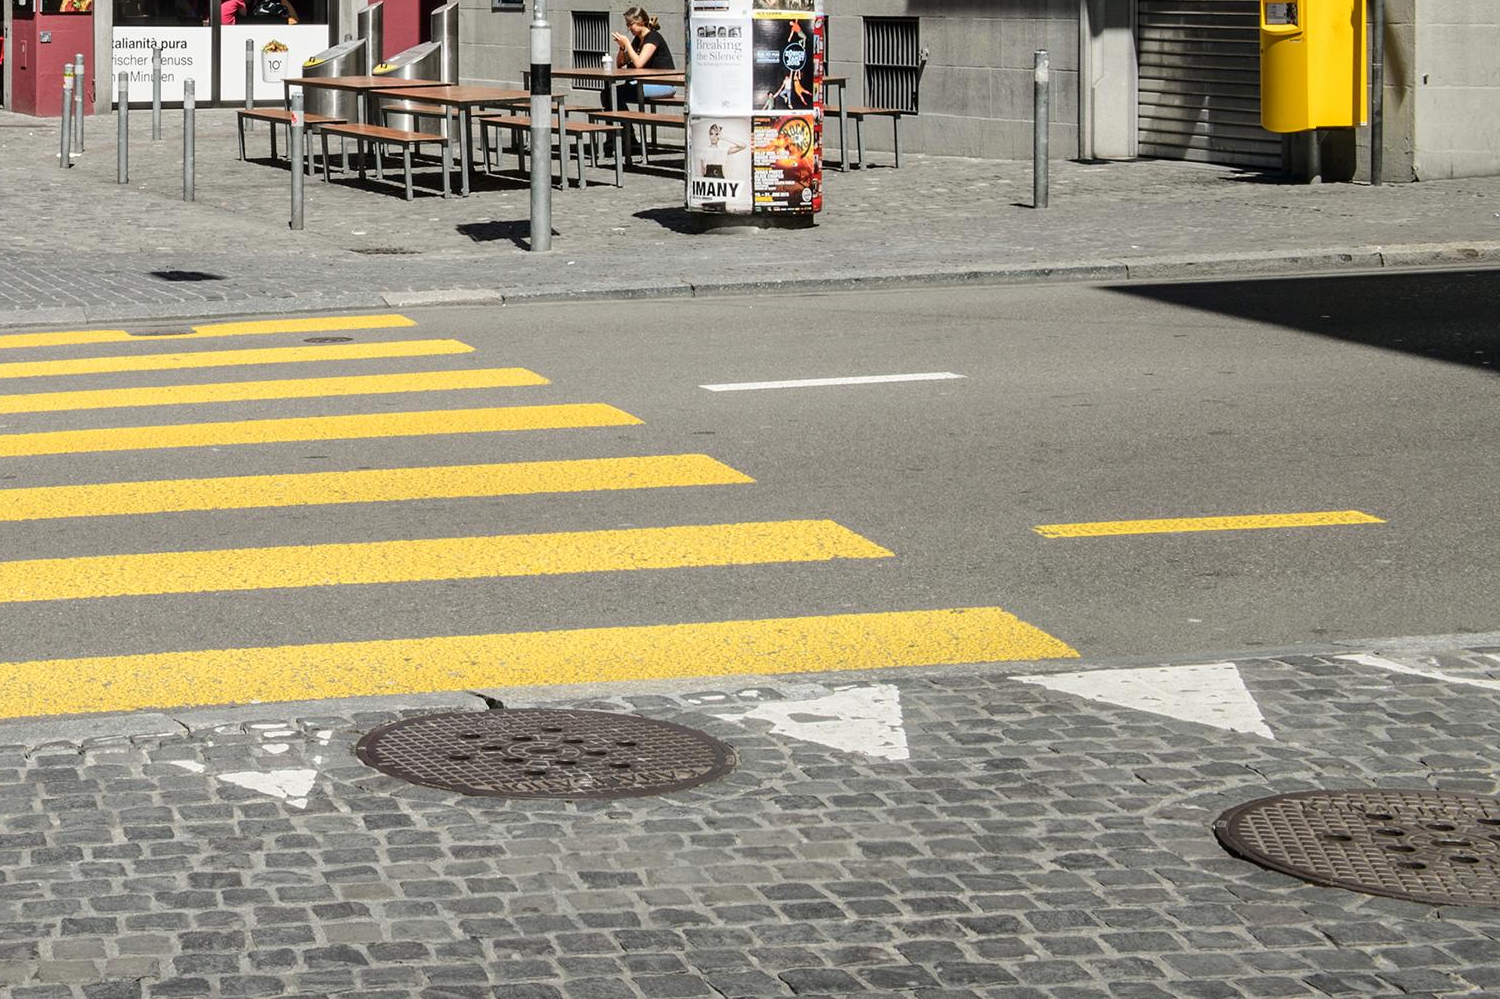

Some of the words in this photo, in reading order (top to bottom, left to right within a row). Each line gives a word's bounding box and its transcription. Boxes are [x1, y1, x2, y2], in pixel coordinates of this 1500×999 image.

[161, 39, 187, 53] pura
[696, 38, 742, 52] Breaking
[696, 51, 708, 60] the
[709, 50, 742, 61] Silence
[692, 180, 739, 198] IMANY
